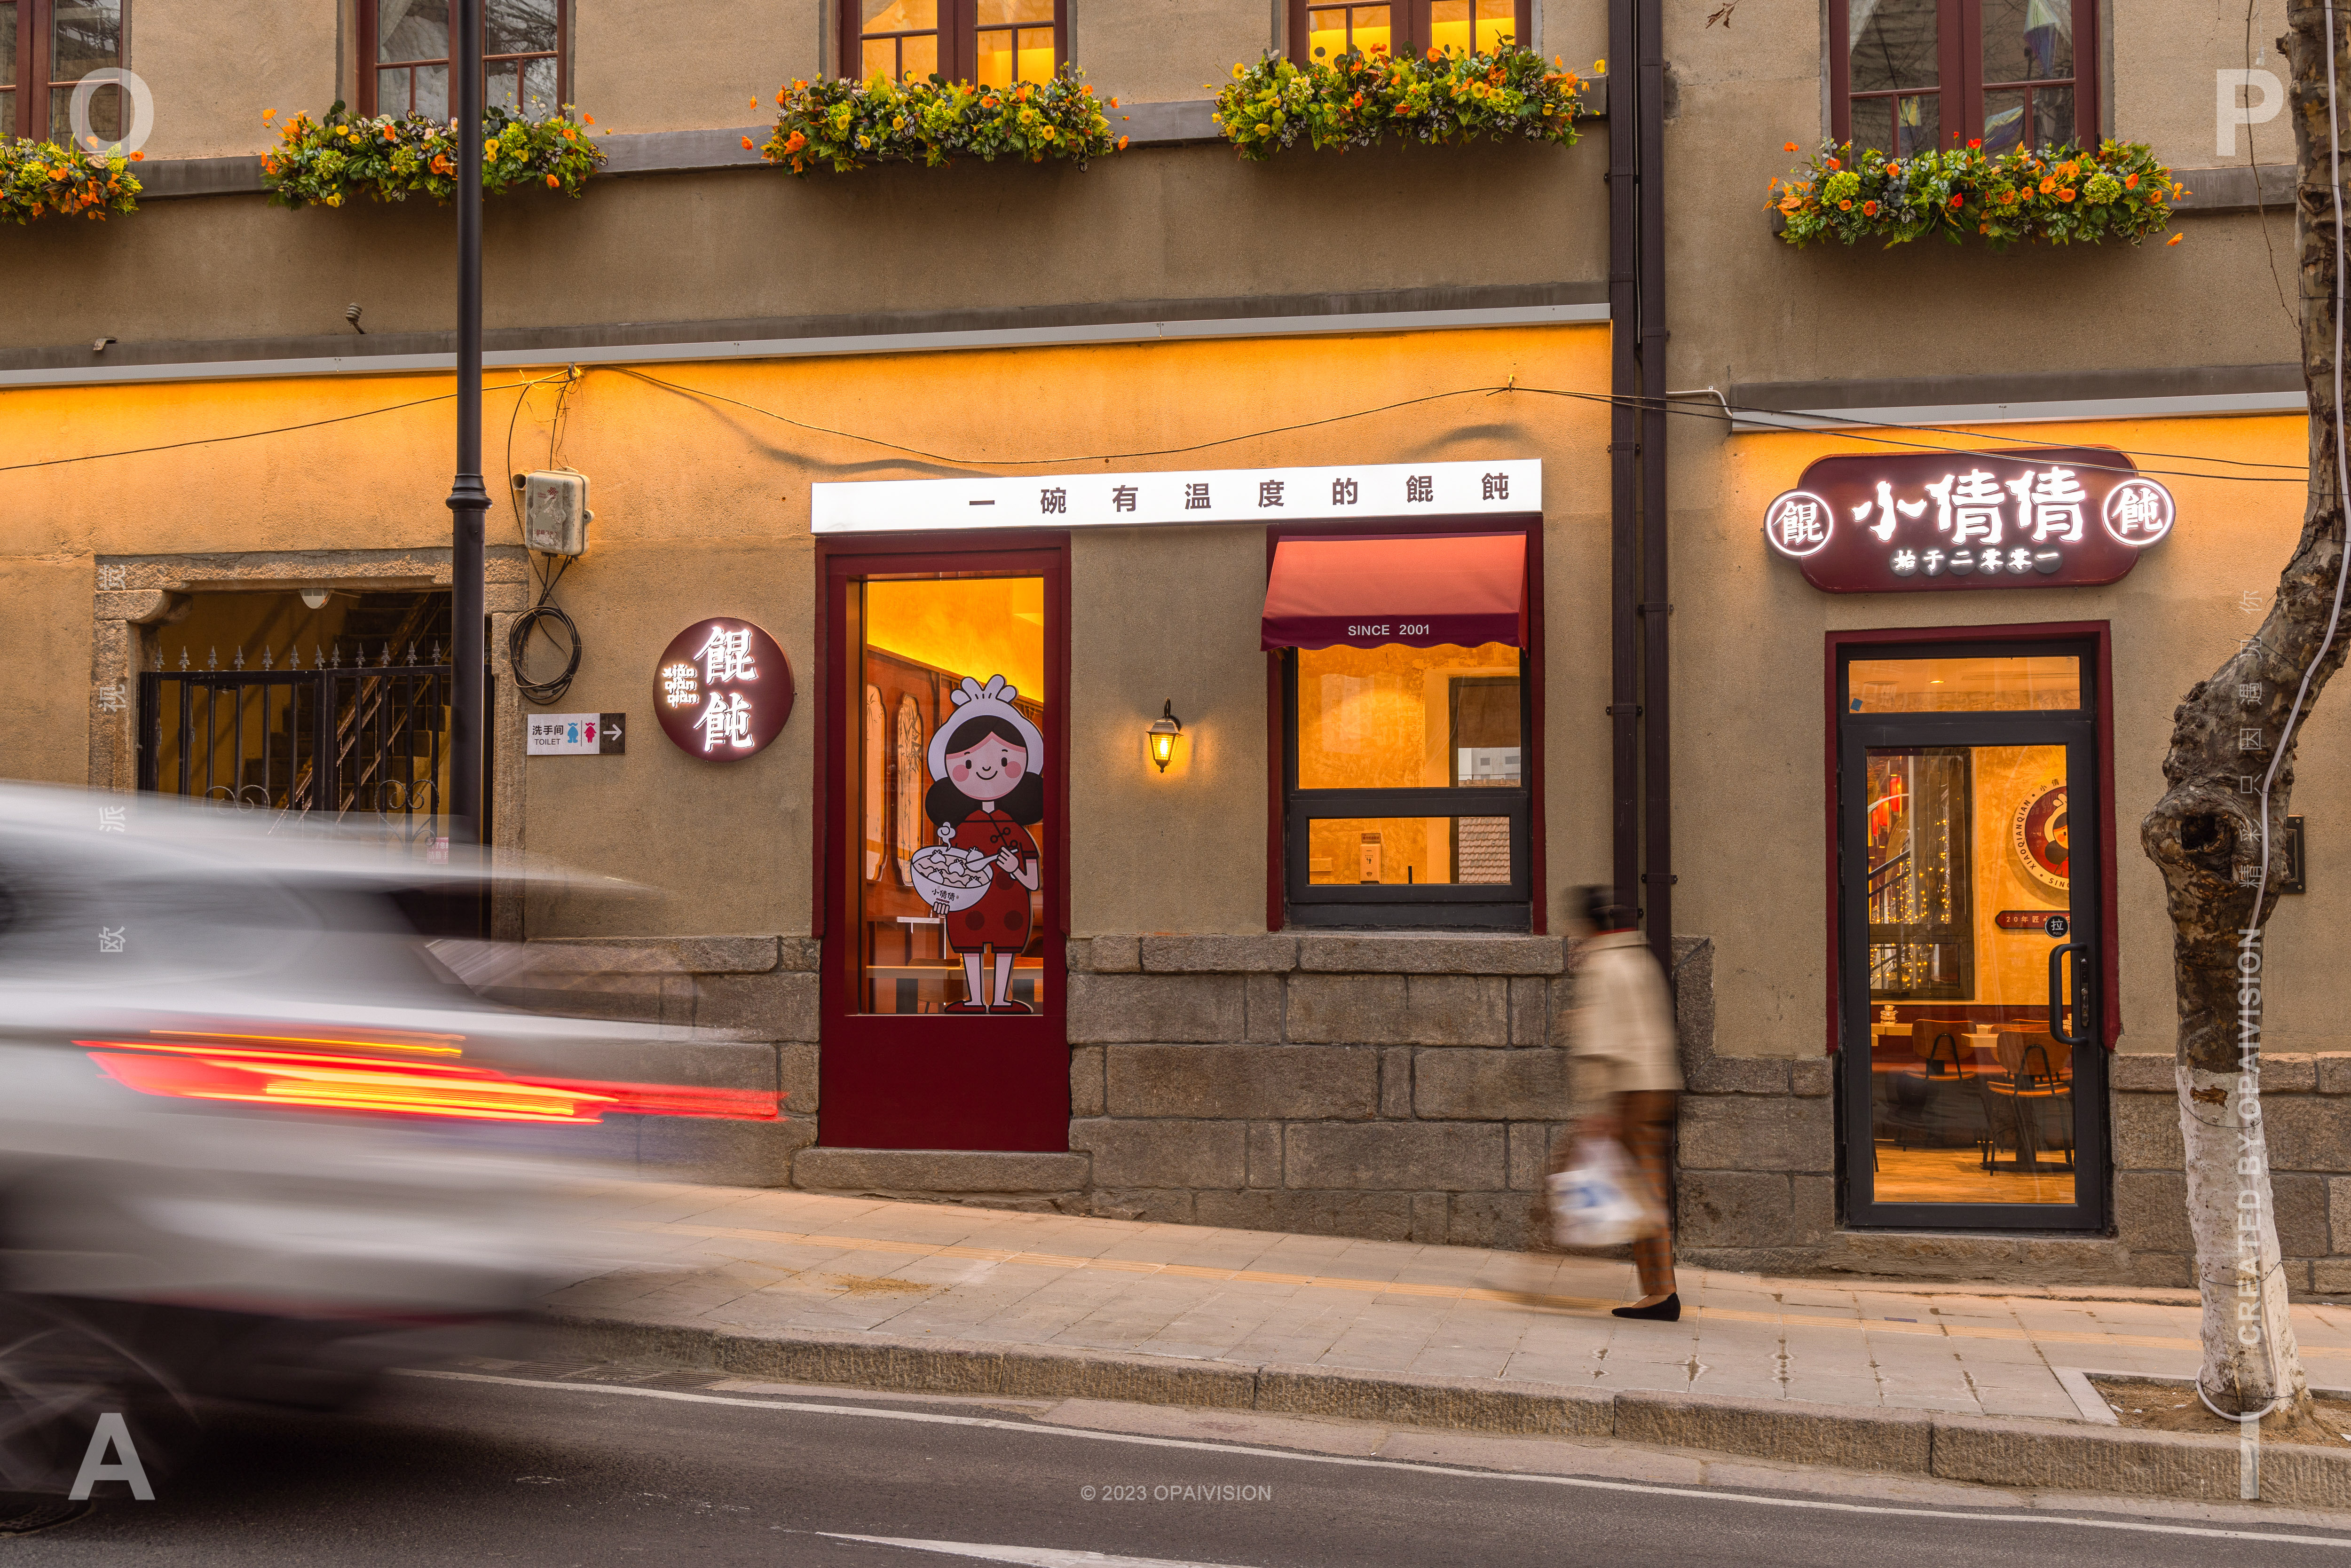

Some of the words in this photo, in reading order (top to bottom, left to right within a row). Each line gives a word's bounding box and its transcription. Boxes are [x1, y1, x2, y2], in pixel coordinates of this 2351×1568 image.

[969, 473, 1509, 514] 一碗有温度的餛飩
[1852, 467, 2086, 544] 小倩倩
[1893, 548, 2059, 571] 始于二零零一
[1348, 625, 1390, 636] SINCE
[1399, 624, 1429, 635] 2001
[532, 725, 563, 735] 洗手间
[2040, 778, 2067, 792] 小倩
[2016, 799, 2037, 870] XIAOQIANQIAN
[2049, 877, 2069, 888] SIN
[931, 889, 955, 901] 小倩倩
[2051, 919, 2064, 930] 拉
